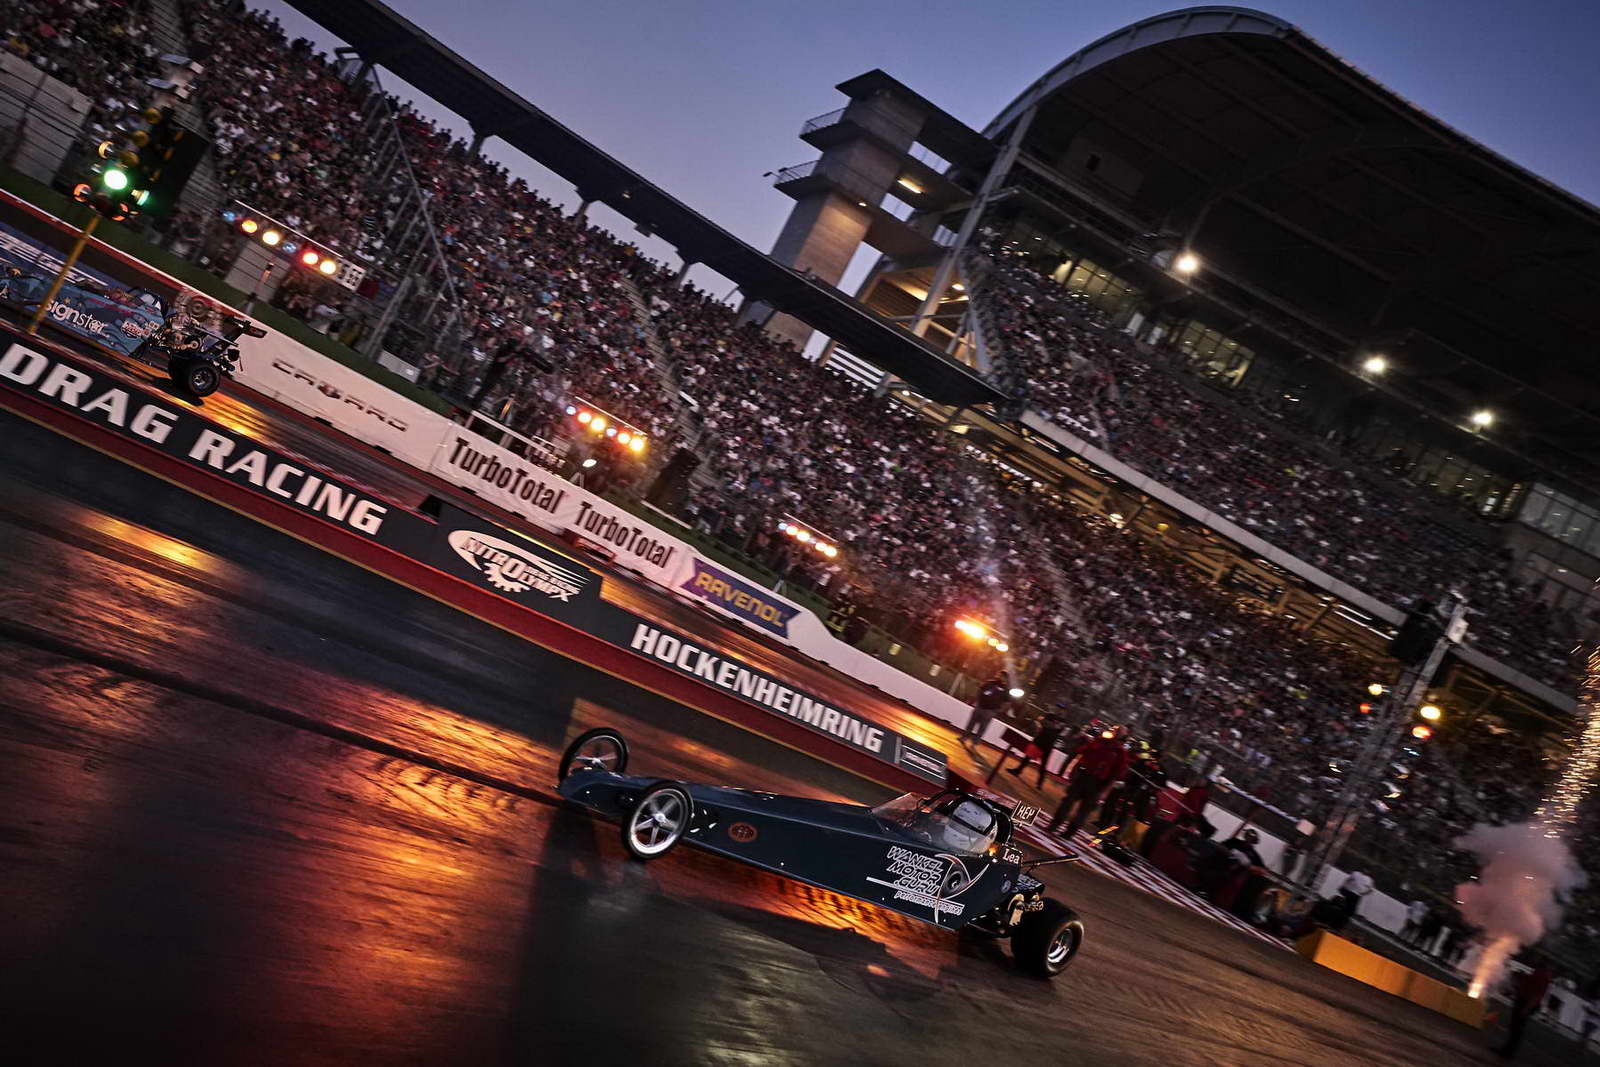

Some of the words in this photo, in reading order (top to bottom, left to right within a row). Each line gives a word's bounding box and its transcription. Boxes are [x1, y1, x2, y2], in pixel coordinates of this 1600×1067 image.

[0, 343, 180, 445] DRAG
[188, 429, 389, 536] RACING
[449, 437, 565, 514] TurboTotal
[574, 500, 674, 569] TurboTotal
[695, 571, 786, 628] RAVENOL
[630, 623, 885, 753] HOCKENHEIMRING
[886, 845, 944, 874] WANKEL
[886, 860, 942, 884] MOTOR
[1002, 848, 1020, 864] Lea
